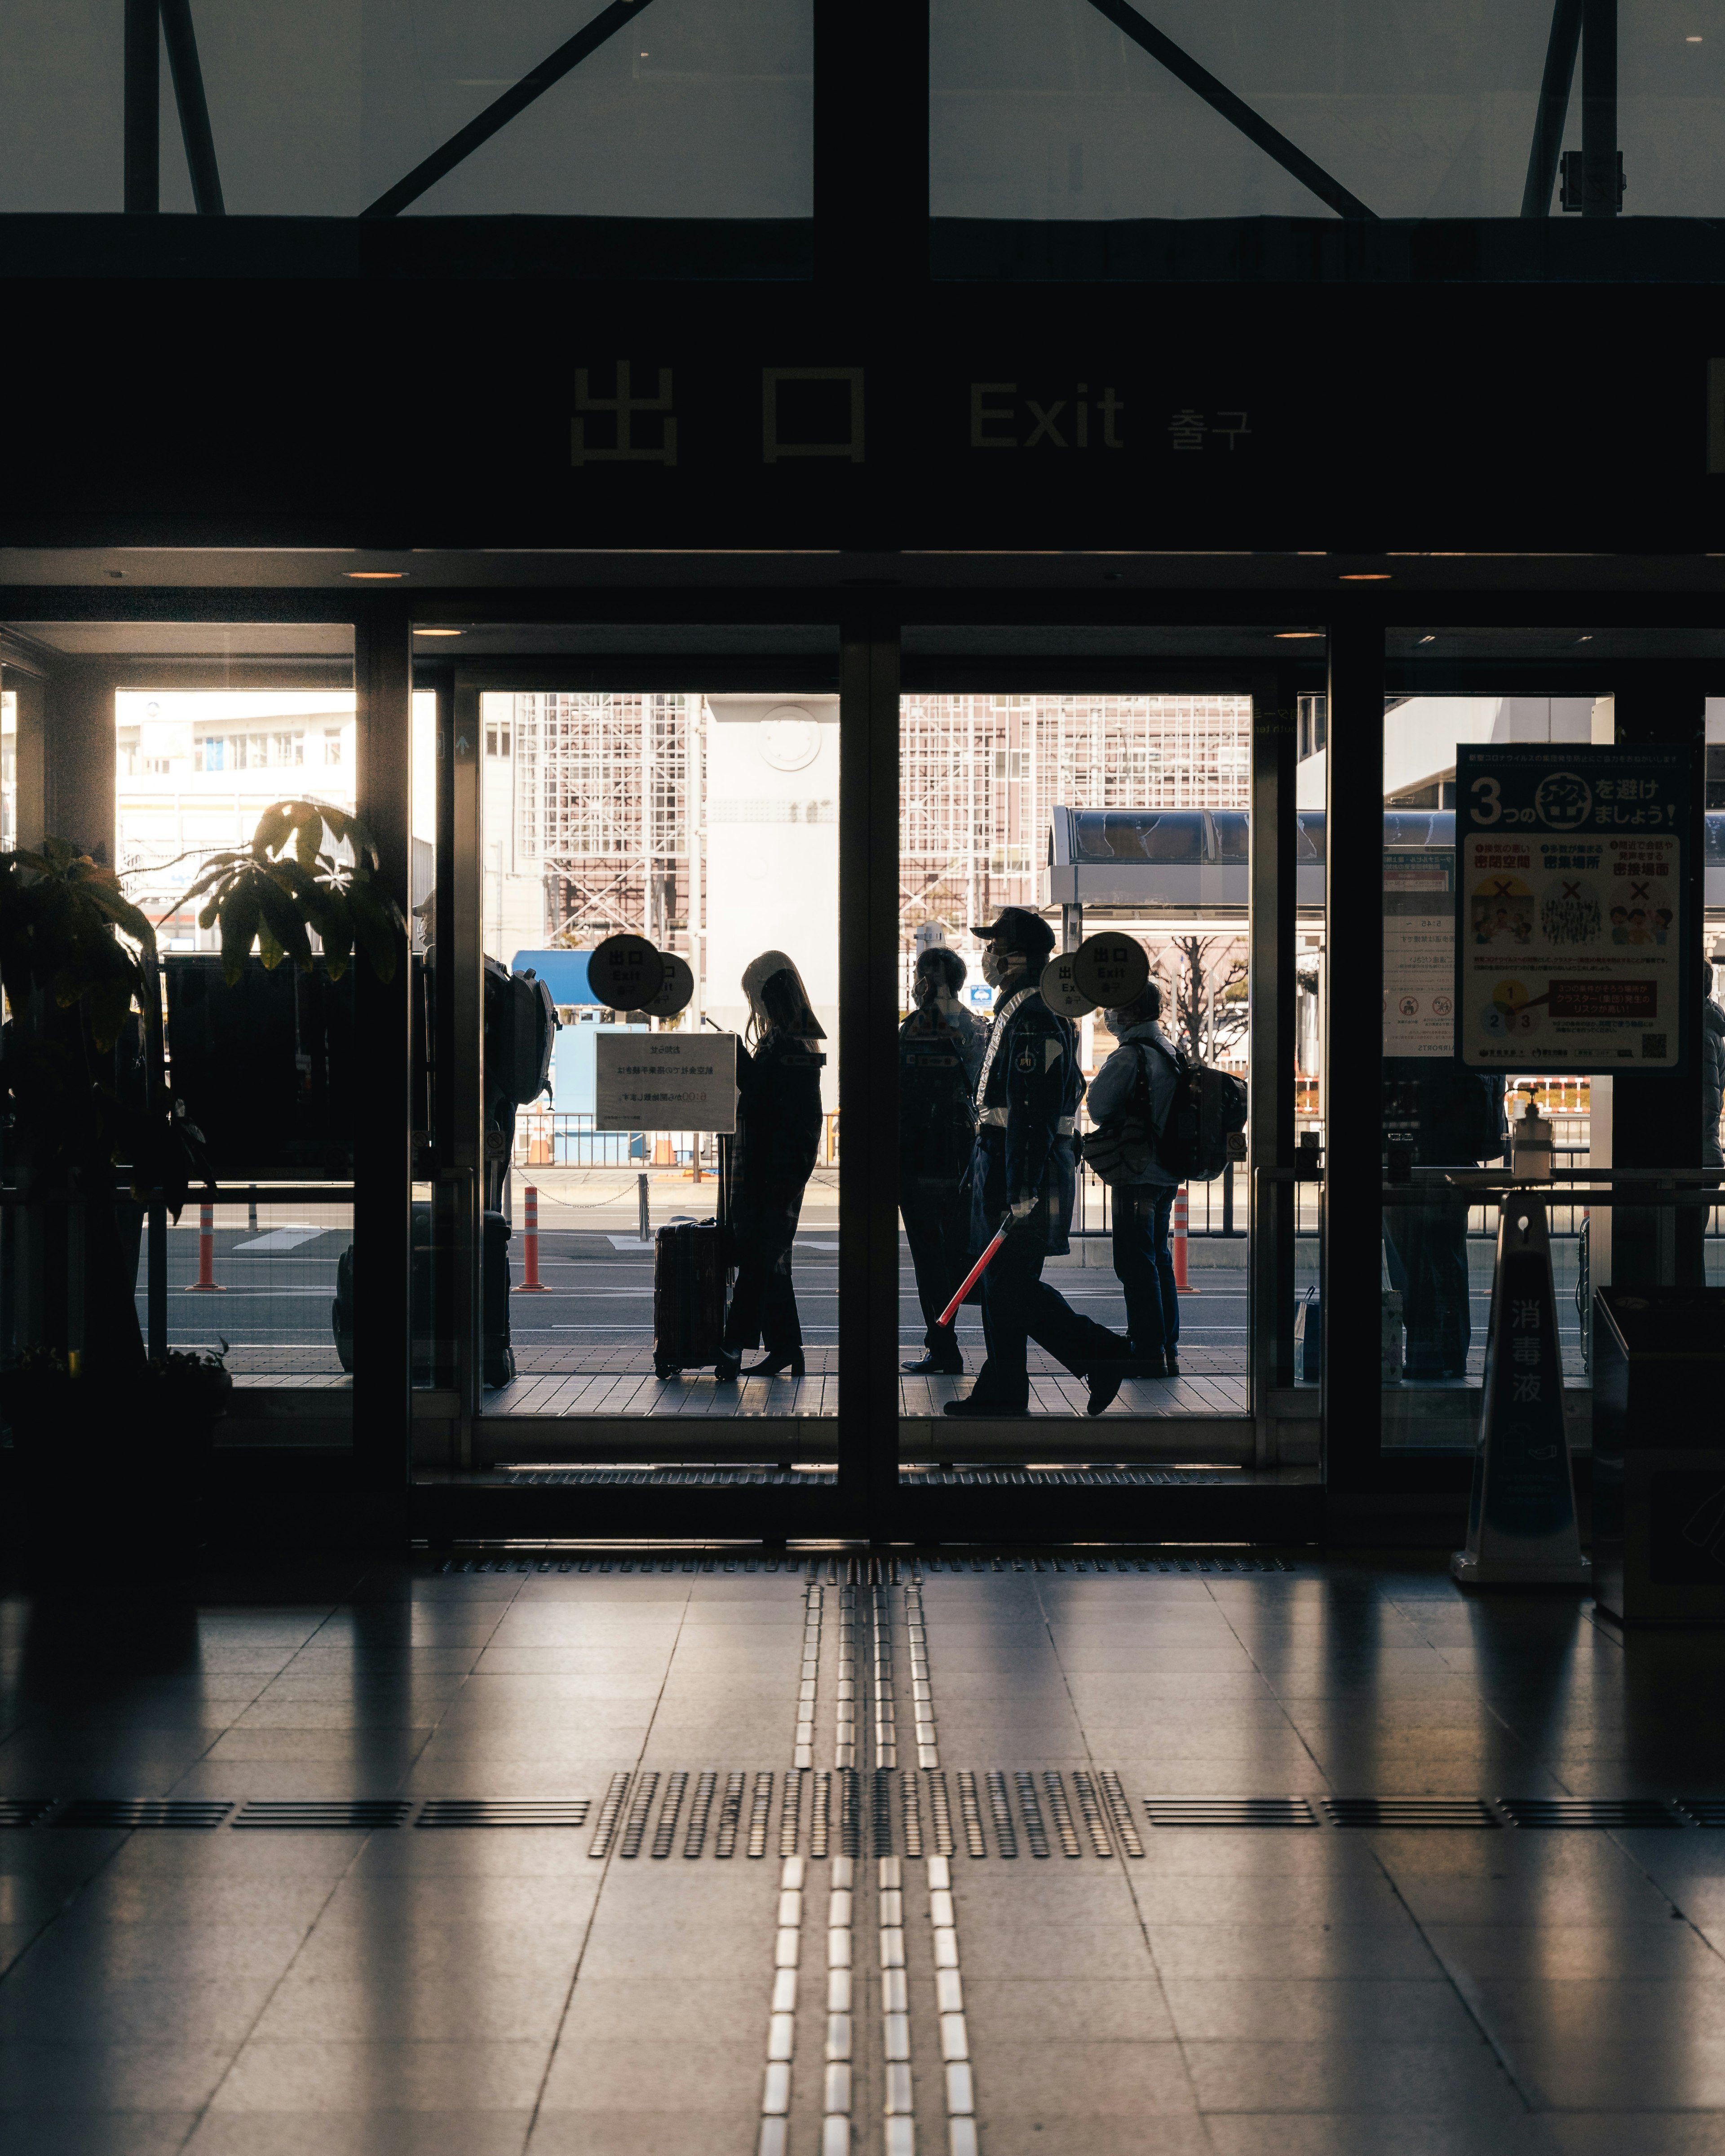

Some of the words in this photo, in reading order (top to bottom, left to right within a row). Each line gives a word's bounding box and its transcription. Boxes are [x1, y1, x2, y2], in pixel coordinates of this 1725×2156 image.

[570, 359, 866, 466] 出口
[970, 382, 1123, 449] Exit
[1167, 408, 1252, 451] 출구
[1595, 779, 1659, 800] を避け
[1475, 855, 1530, 869] 密閉空間
[1544, 855, 1600, 870] 密集場所
[1614, 863, 1669, 876] 密接場面
[609, 950, 643, 965] 出口
[1094, 947, 1128, 963] 出口
[613, 970, 640, 981] Exit
[1059, 966, 1071, 979] 出
[1097, 968, 1125, 978] Exit
[1062, 983, 1075, 992] Ex
[1507, 987, 1513, 998] 1
[1559, 985, 1647, 993] 3つの条件がそろう場所が
[1491, 1015, 1499, 1027] 2
[1522, 1015, 1530, 1027] 3
[1511, 1299, 1543, 1403] 消毒液
